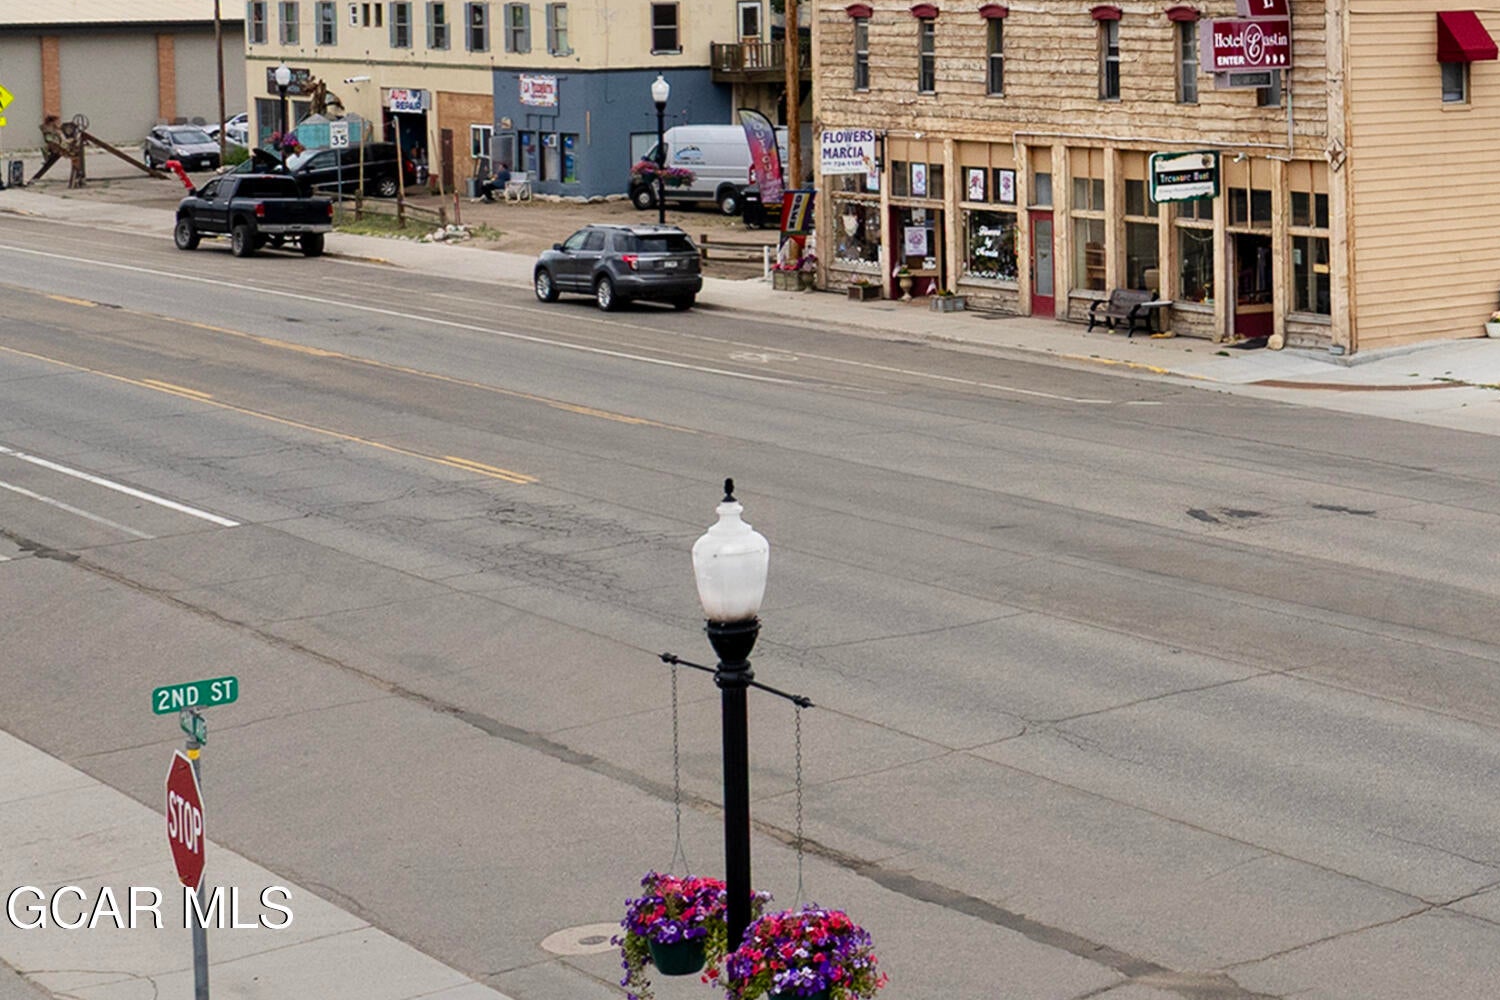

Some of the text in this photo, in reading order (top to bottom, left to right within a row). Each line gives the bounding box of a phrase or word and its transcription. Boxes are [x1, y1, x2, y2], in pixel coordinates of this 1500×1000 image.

[1214, 32, 1244, 48] Hotel
[1217, 56, 1245, 66] ENTER
[391, 89, 407, 100] AUTO
[395, 101, 422, 110] REPAIR
[332, 135, 348, 146] 35
[823, 130, 873, 143] FLOWERS
[823, 146, 864, 159] MARCIA
[158, 680, 233, 711] 2ND ST
[168, 790, 202, 855] STOP
